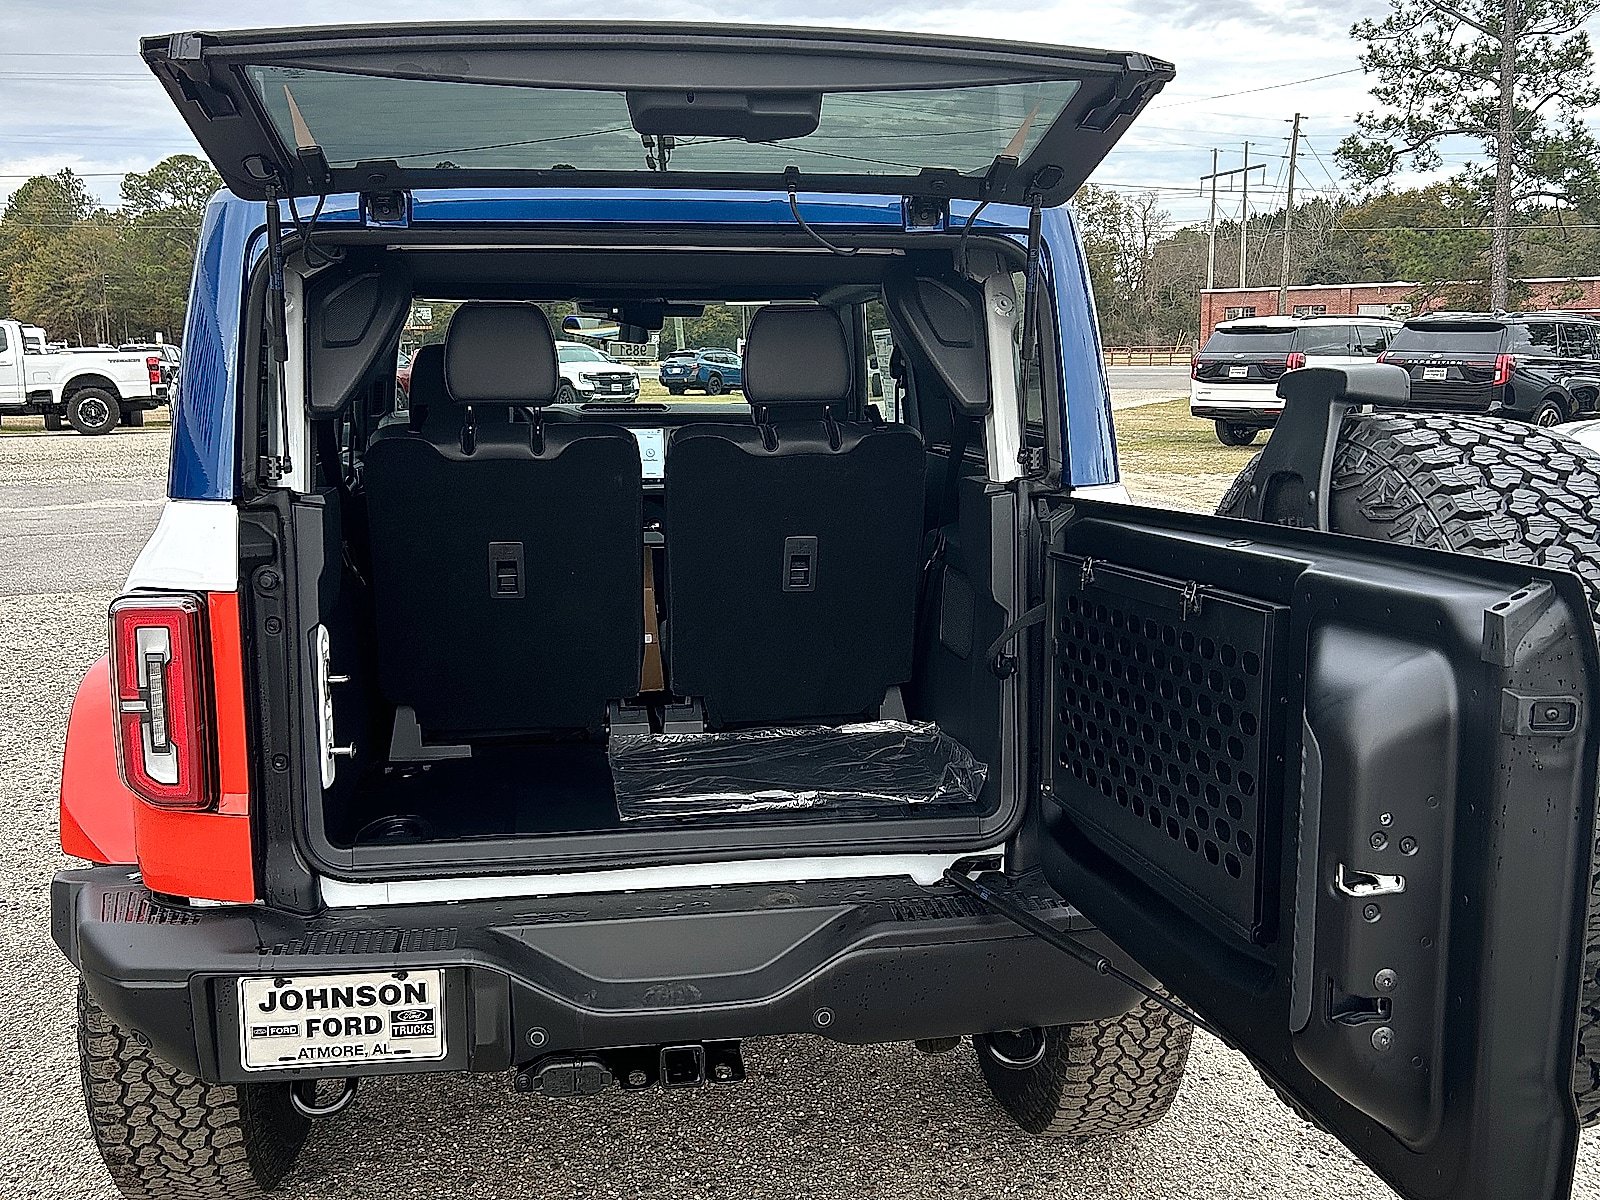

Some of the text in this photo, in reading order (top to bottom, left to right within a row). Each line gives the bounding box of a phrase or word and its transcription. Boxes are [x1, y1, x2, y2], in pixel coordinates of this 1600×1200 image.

[258, 982, 426, 1012] JOHNSON
[270, 1026, 297, 1035] FORD
[306, 1015, 383, 1038] FORD
[392, 1024, 434, 1036] TRUCKS
[298, 1043, 393, 1059] ATMORE, AL
